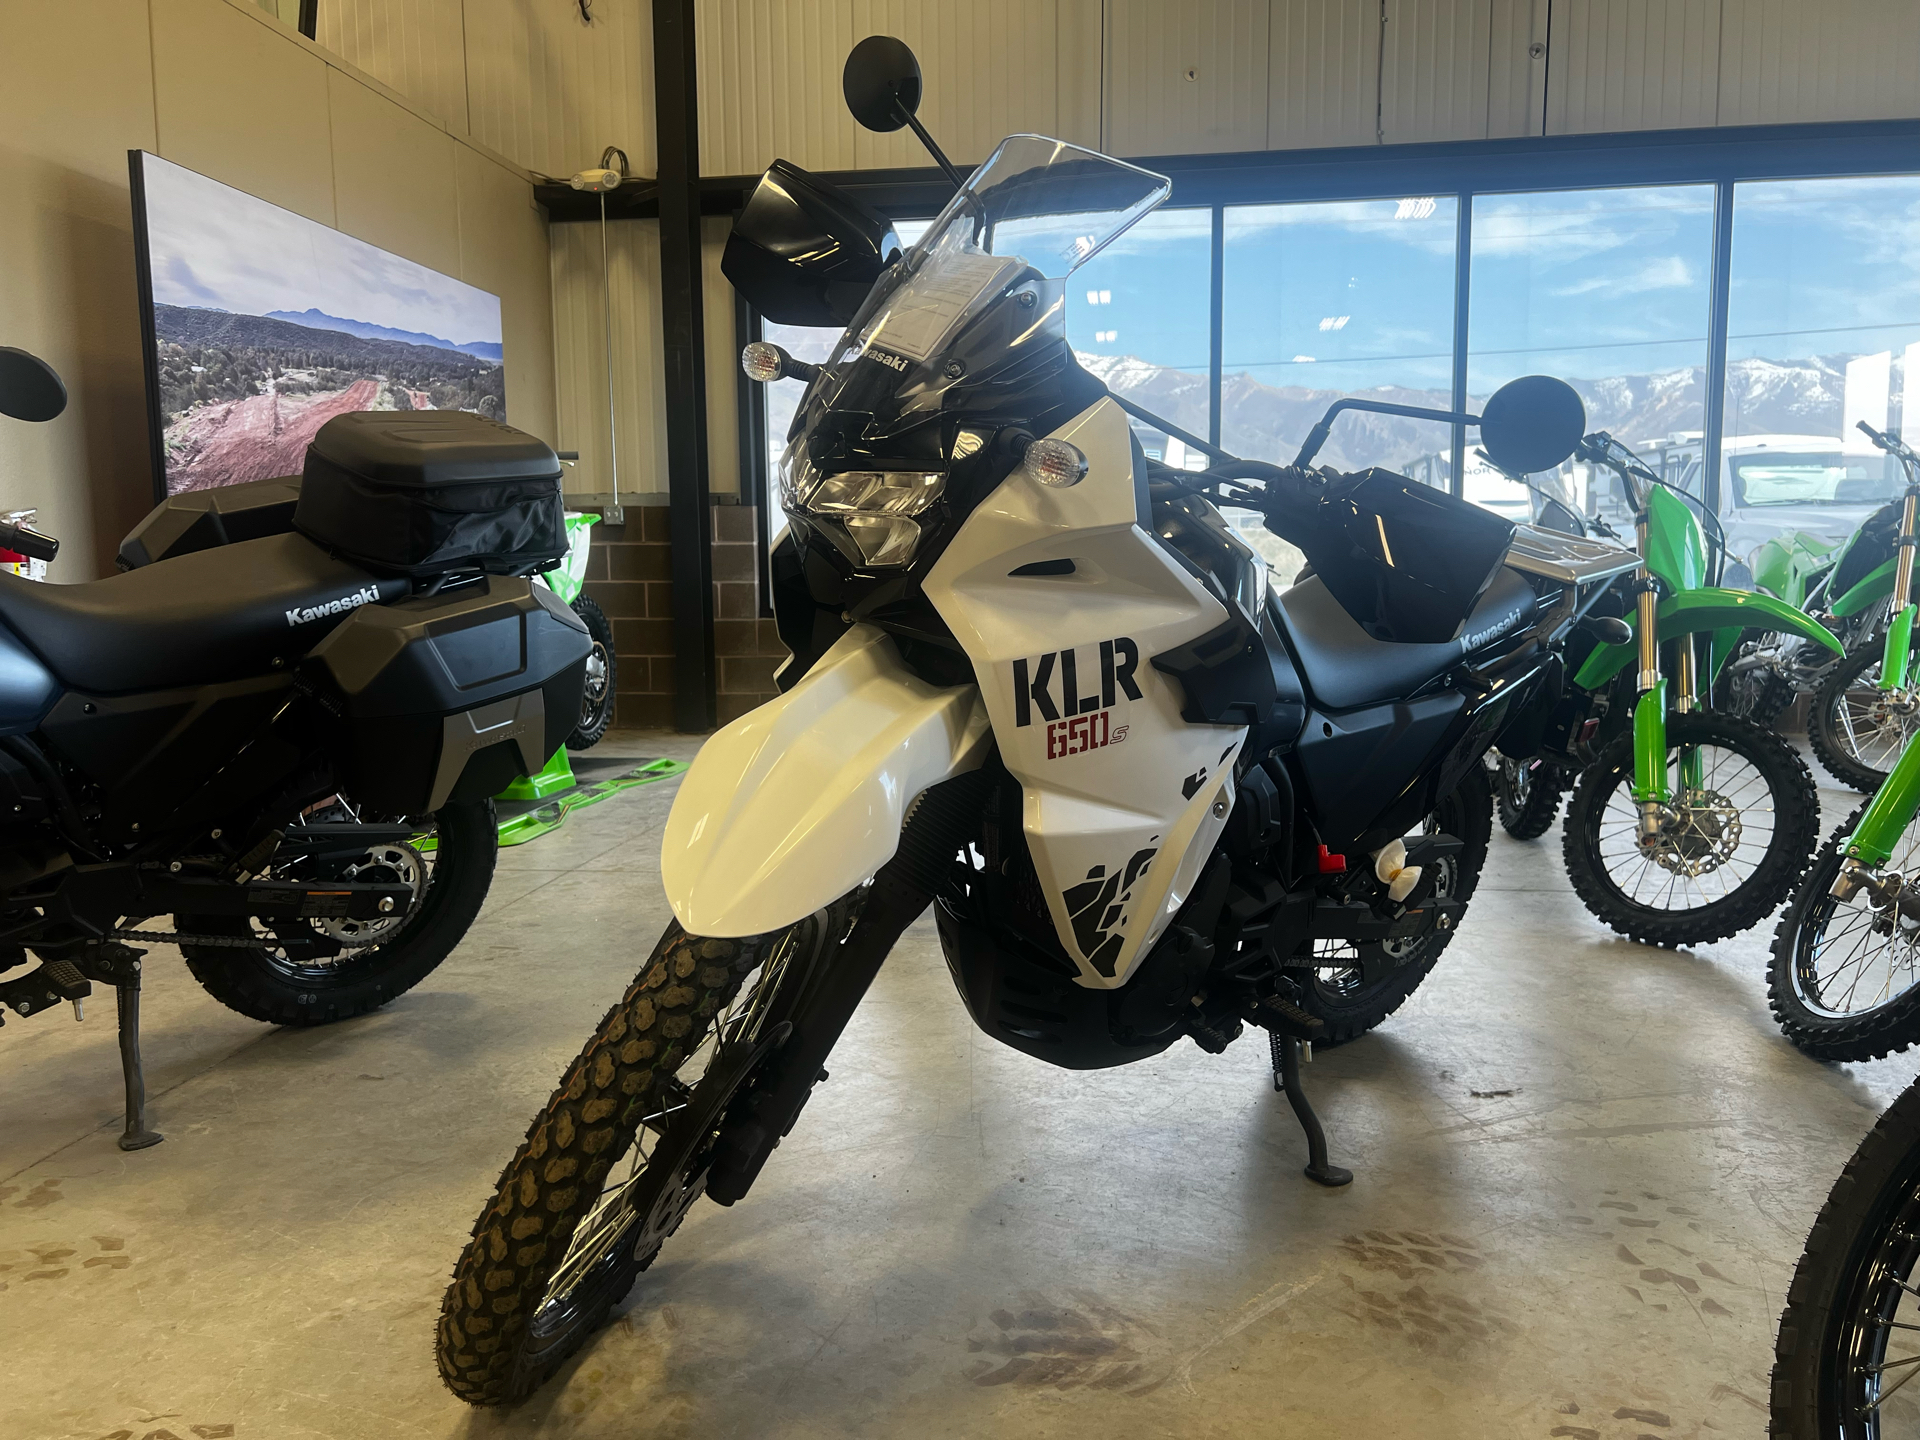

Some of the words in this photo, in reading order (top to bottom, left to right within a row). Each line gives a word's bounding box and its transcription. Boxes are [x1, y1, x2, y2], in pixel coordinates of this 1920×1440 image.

[285, 584, 380, 627] Kawasaki
[1459, 607, 1521, 654] Kawasaki
[1012, 636, 1144, 728] KLR
